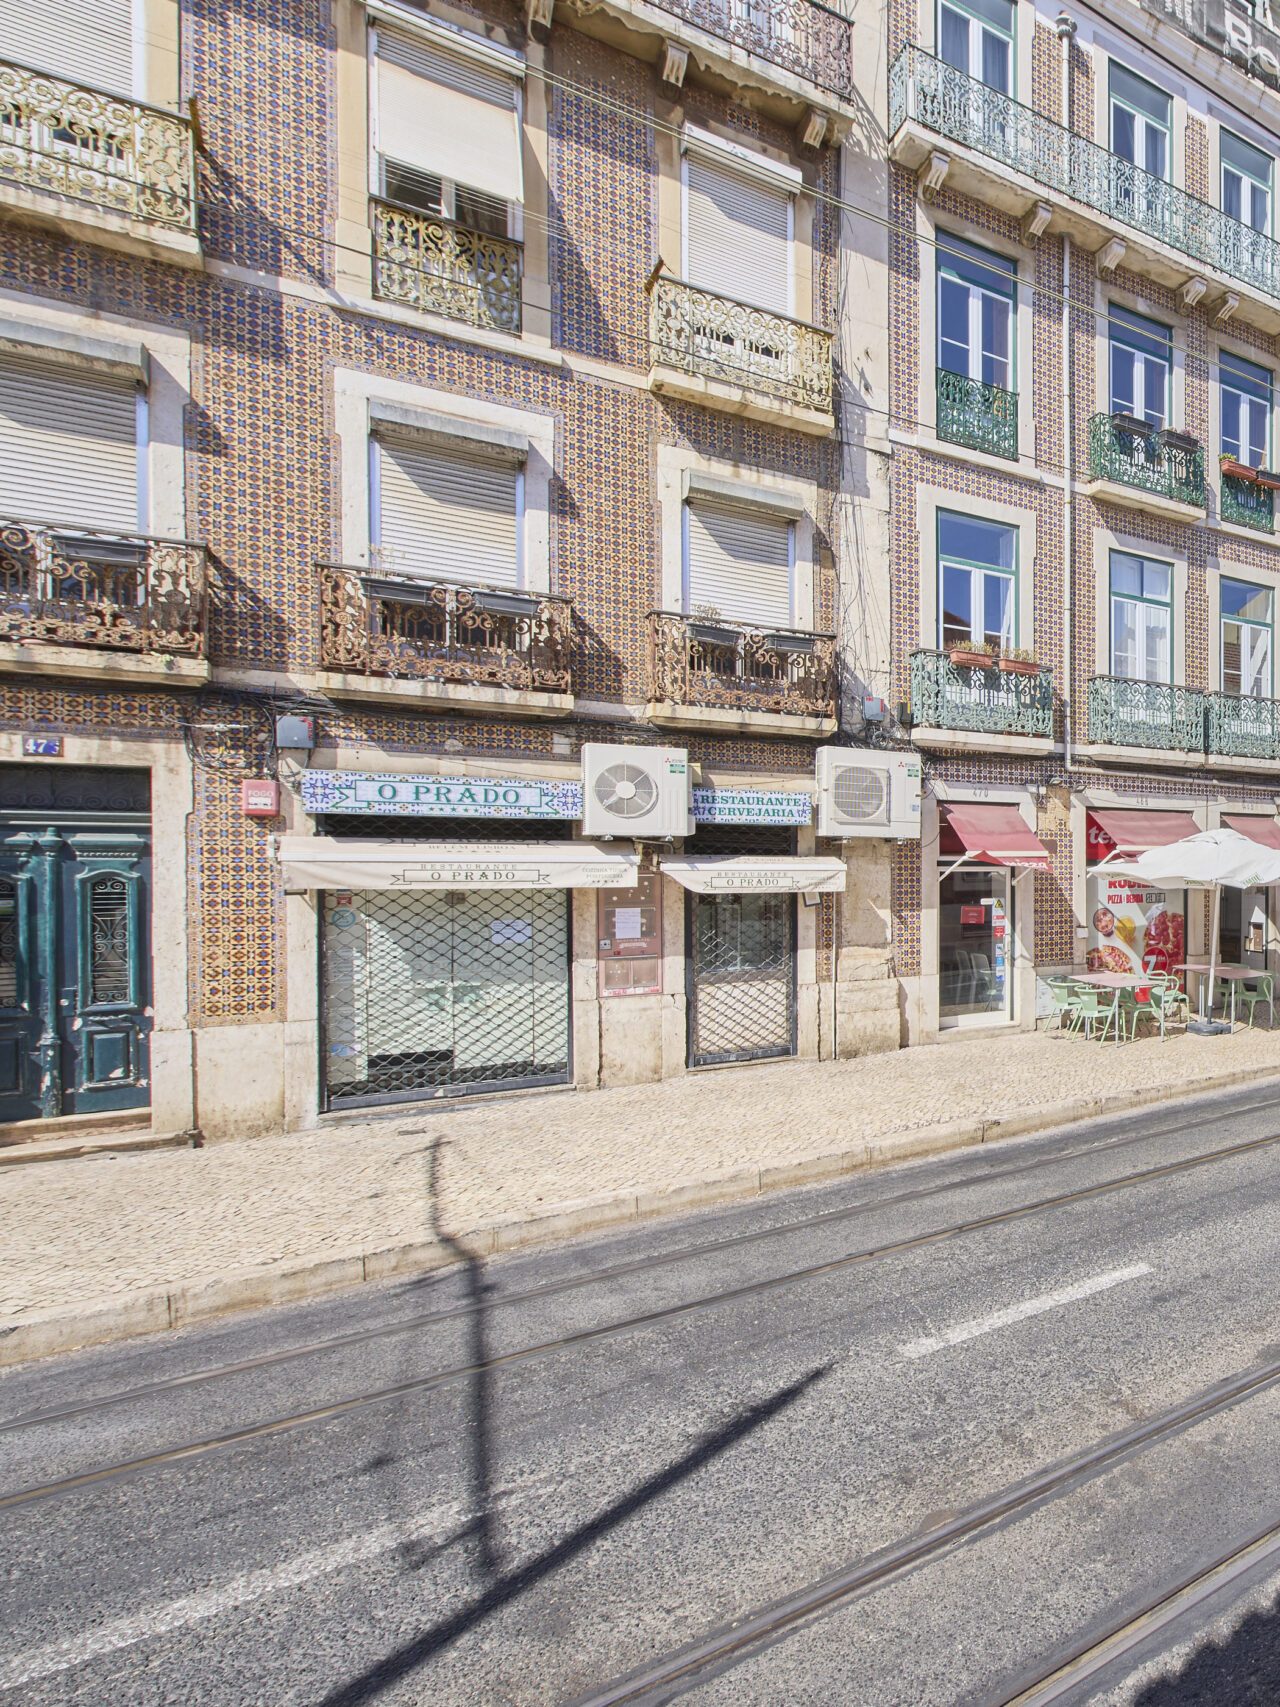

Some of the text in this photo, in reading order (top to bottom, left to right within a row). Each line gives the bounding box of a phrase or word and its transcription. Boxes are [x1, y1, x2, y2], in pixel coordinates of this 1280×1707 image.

[248, 789, 273, 797] FOGO
[378, 783, 521, 804] O PRADO
[700, 795, 801, 807] RESTAURANTE
[707, 806, 795, 818] CERVEJARIA
[430, 871, 516, 881] O PRADO
[740, 878, 779, 887] PRADO
